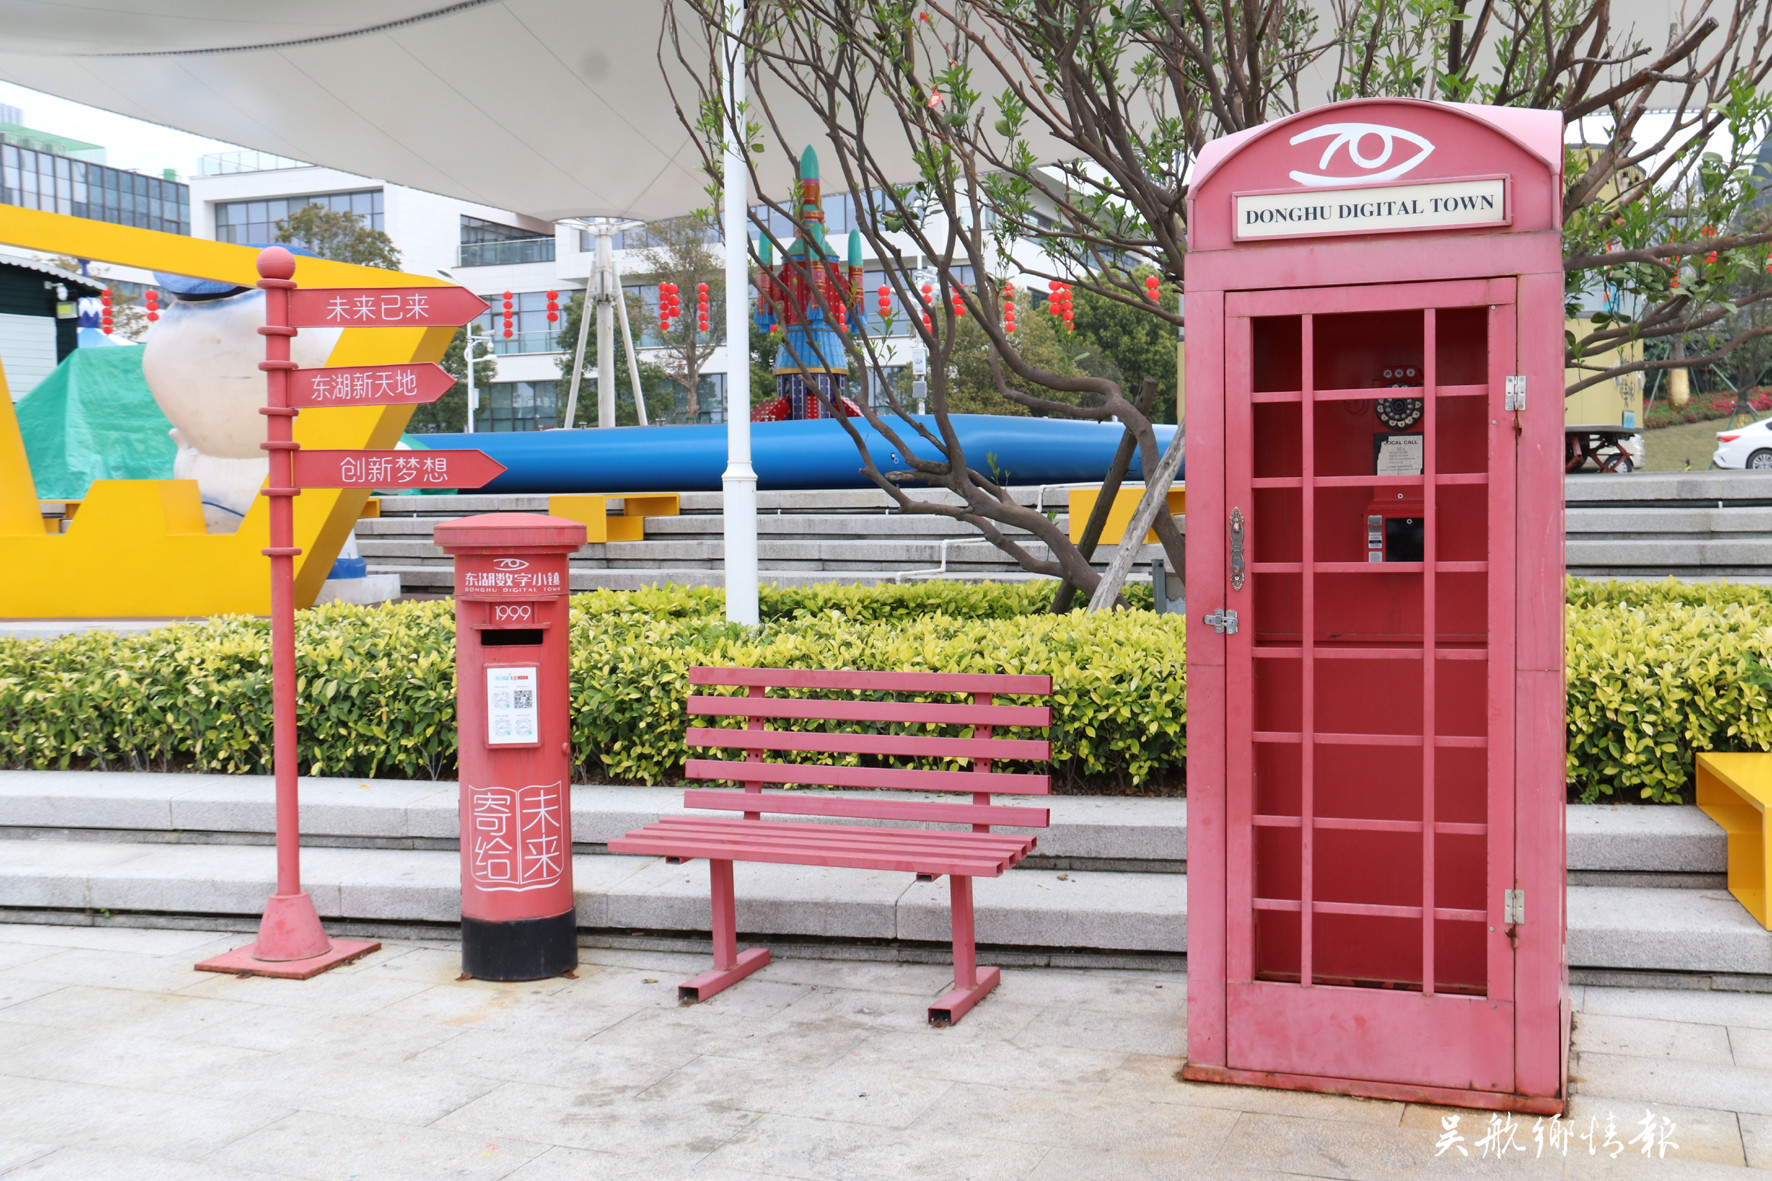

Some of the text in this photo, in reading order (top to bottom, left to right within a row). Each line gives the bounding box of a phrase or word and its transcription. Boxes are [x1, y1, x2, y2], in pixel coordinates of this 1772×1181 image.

[1245, 194, 1494, 225] DONGHU DIGITAL TOWN
[326, 293, 429, 322] 未来已来
[310, 369, 418, 401] 东湖新天地
[340, 456, 448, 484] 创新梦想
[465, 572, 560, 587] 东湖数字小镇
[495, 605, 531, 620] 1999
[473, 792, 512, 879] 寄给
[522, 789, 560, 878] 未来
